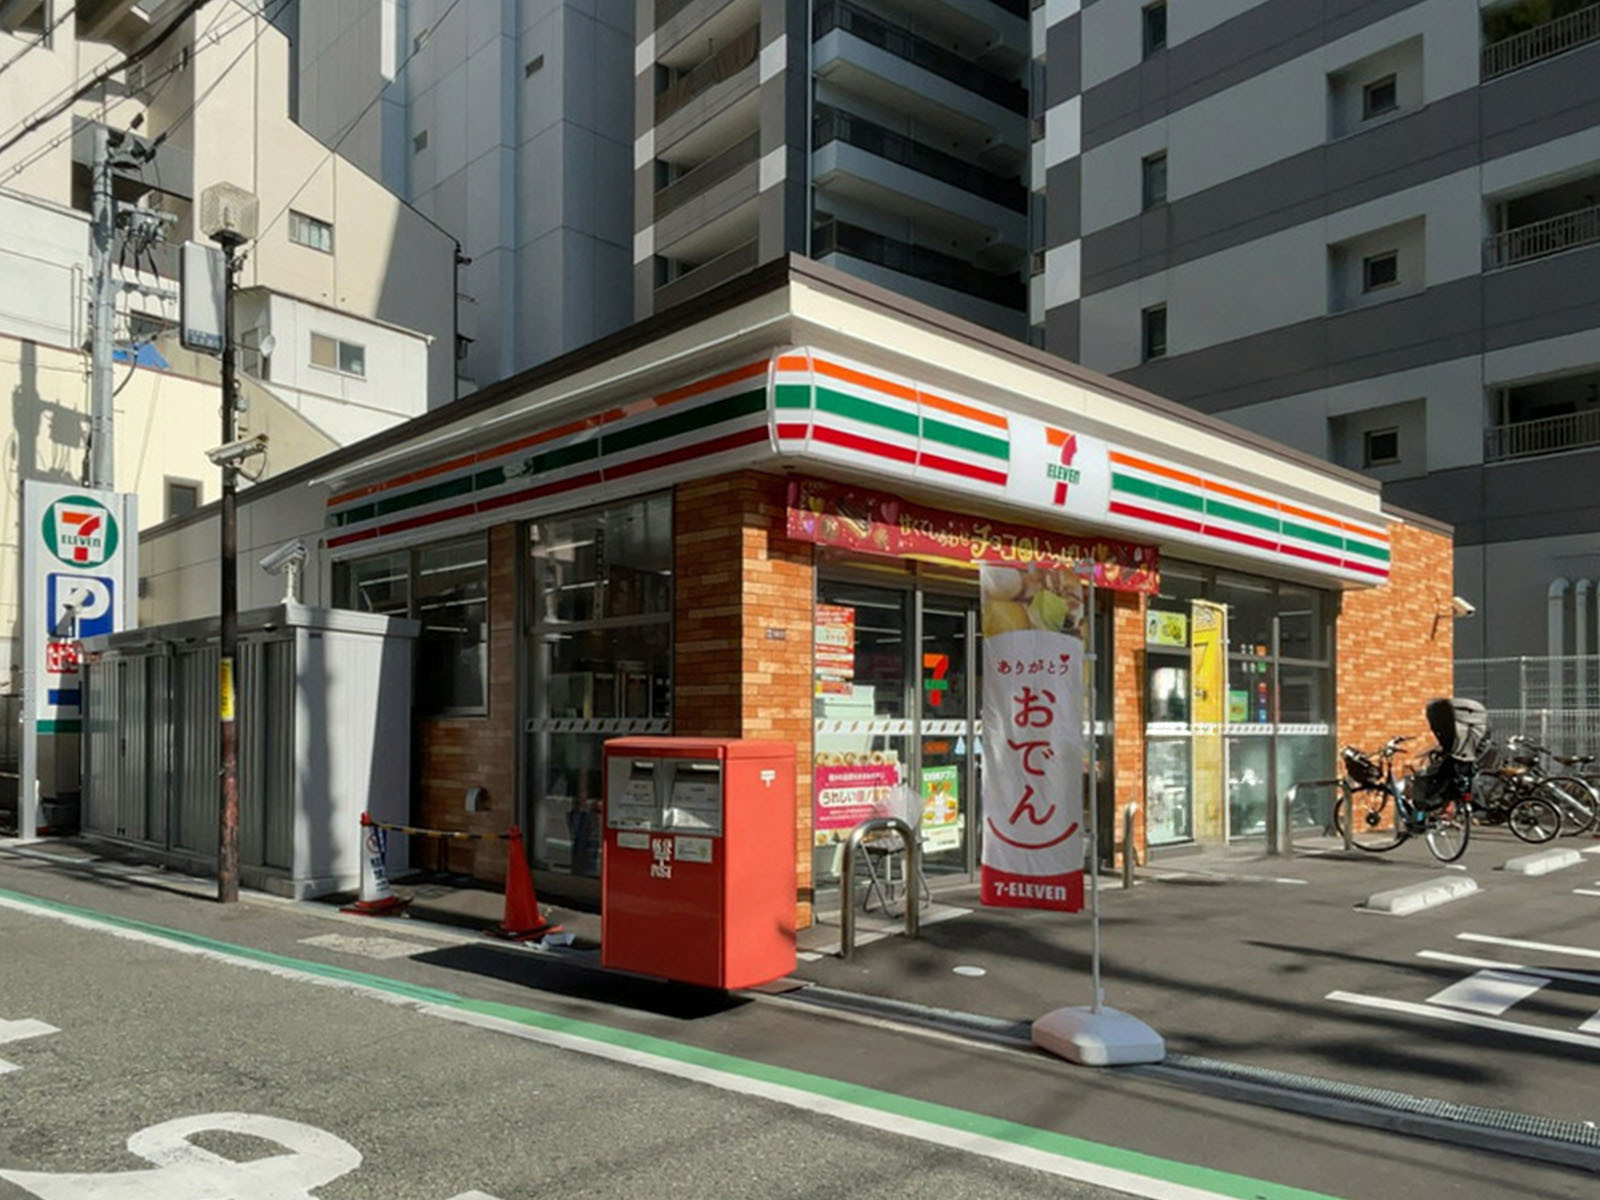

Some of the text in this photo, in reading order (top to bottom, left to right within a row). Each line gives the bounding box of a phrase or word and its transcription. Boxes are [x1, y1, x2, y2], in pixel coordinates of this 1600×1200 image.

[1045, 427, 1078, 506] 7
[62, 511, 101, 562] 7
[55, 576, 110, 638] P
[997, 656, 1070, 676] ありがとう
[1008, 686, 1057, 826] おでん
